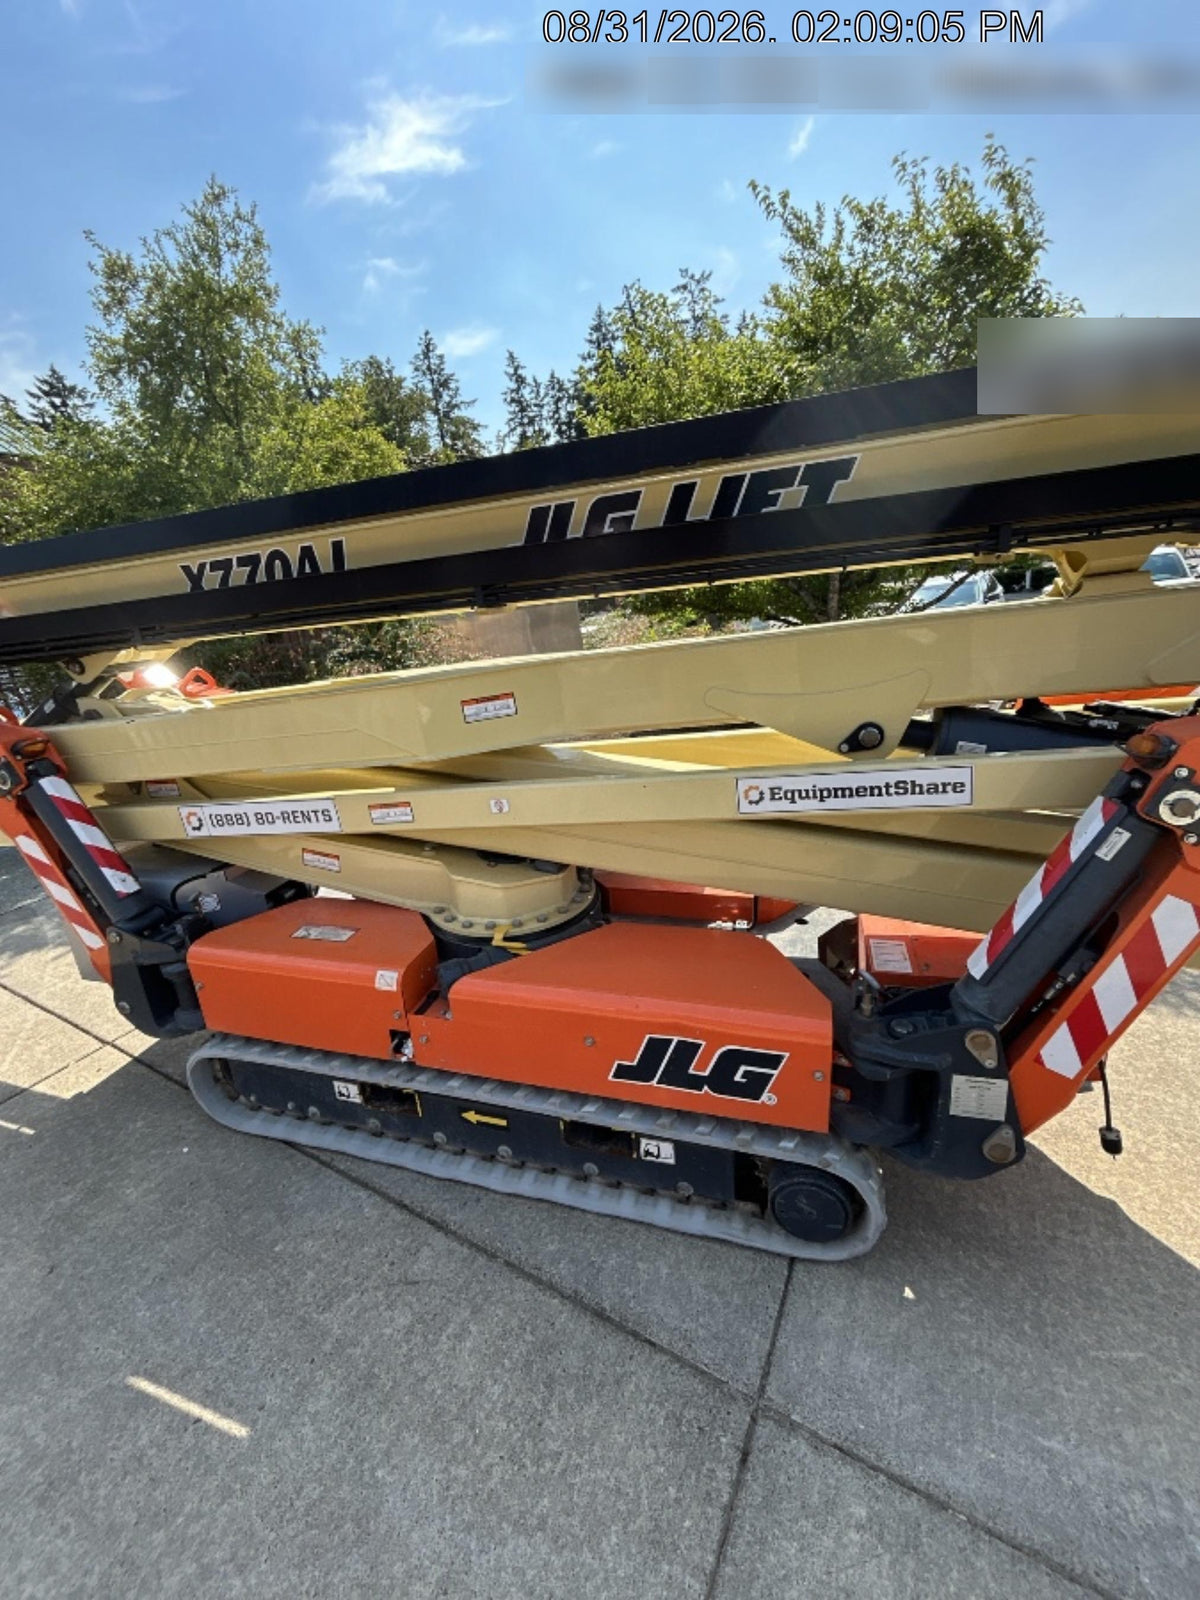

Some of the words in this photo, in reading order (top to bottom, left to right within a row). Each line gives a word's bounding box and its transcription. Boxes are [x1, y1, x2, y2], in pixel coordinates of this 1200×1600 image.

[768, 779, 966, 804] EquipmentShare
[208, 811, 251, 829] (888)
[255, 808, 333, 826] 80-RENTS
